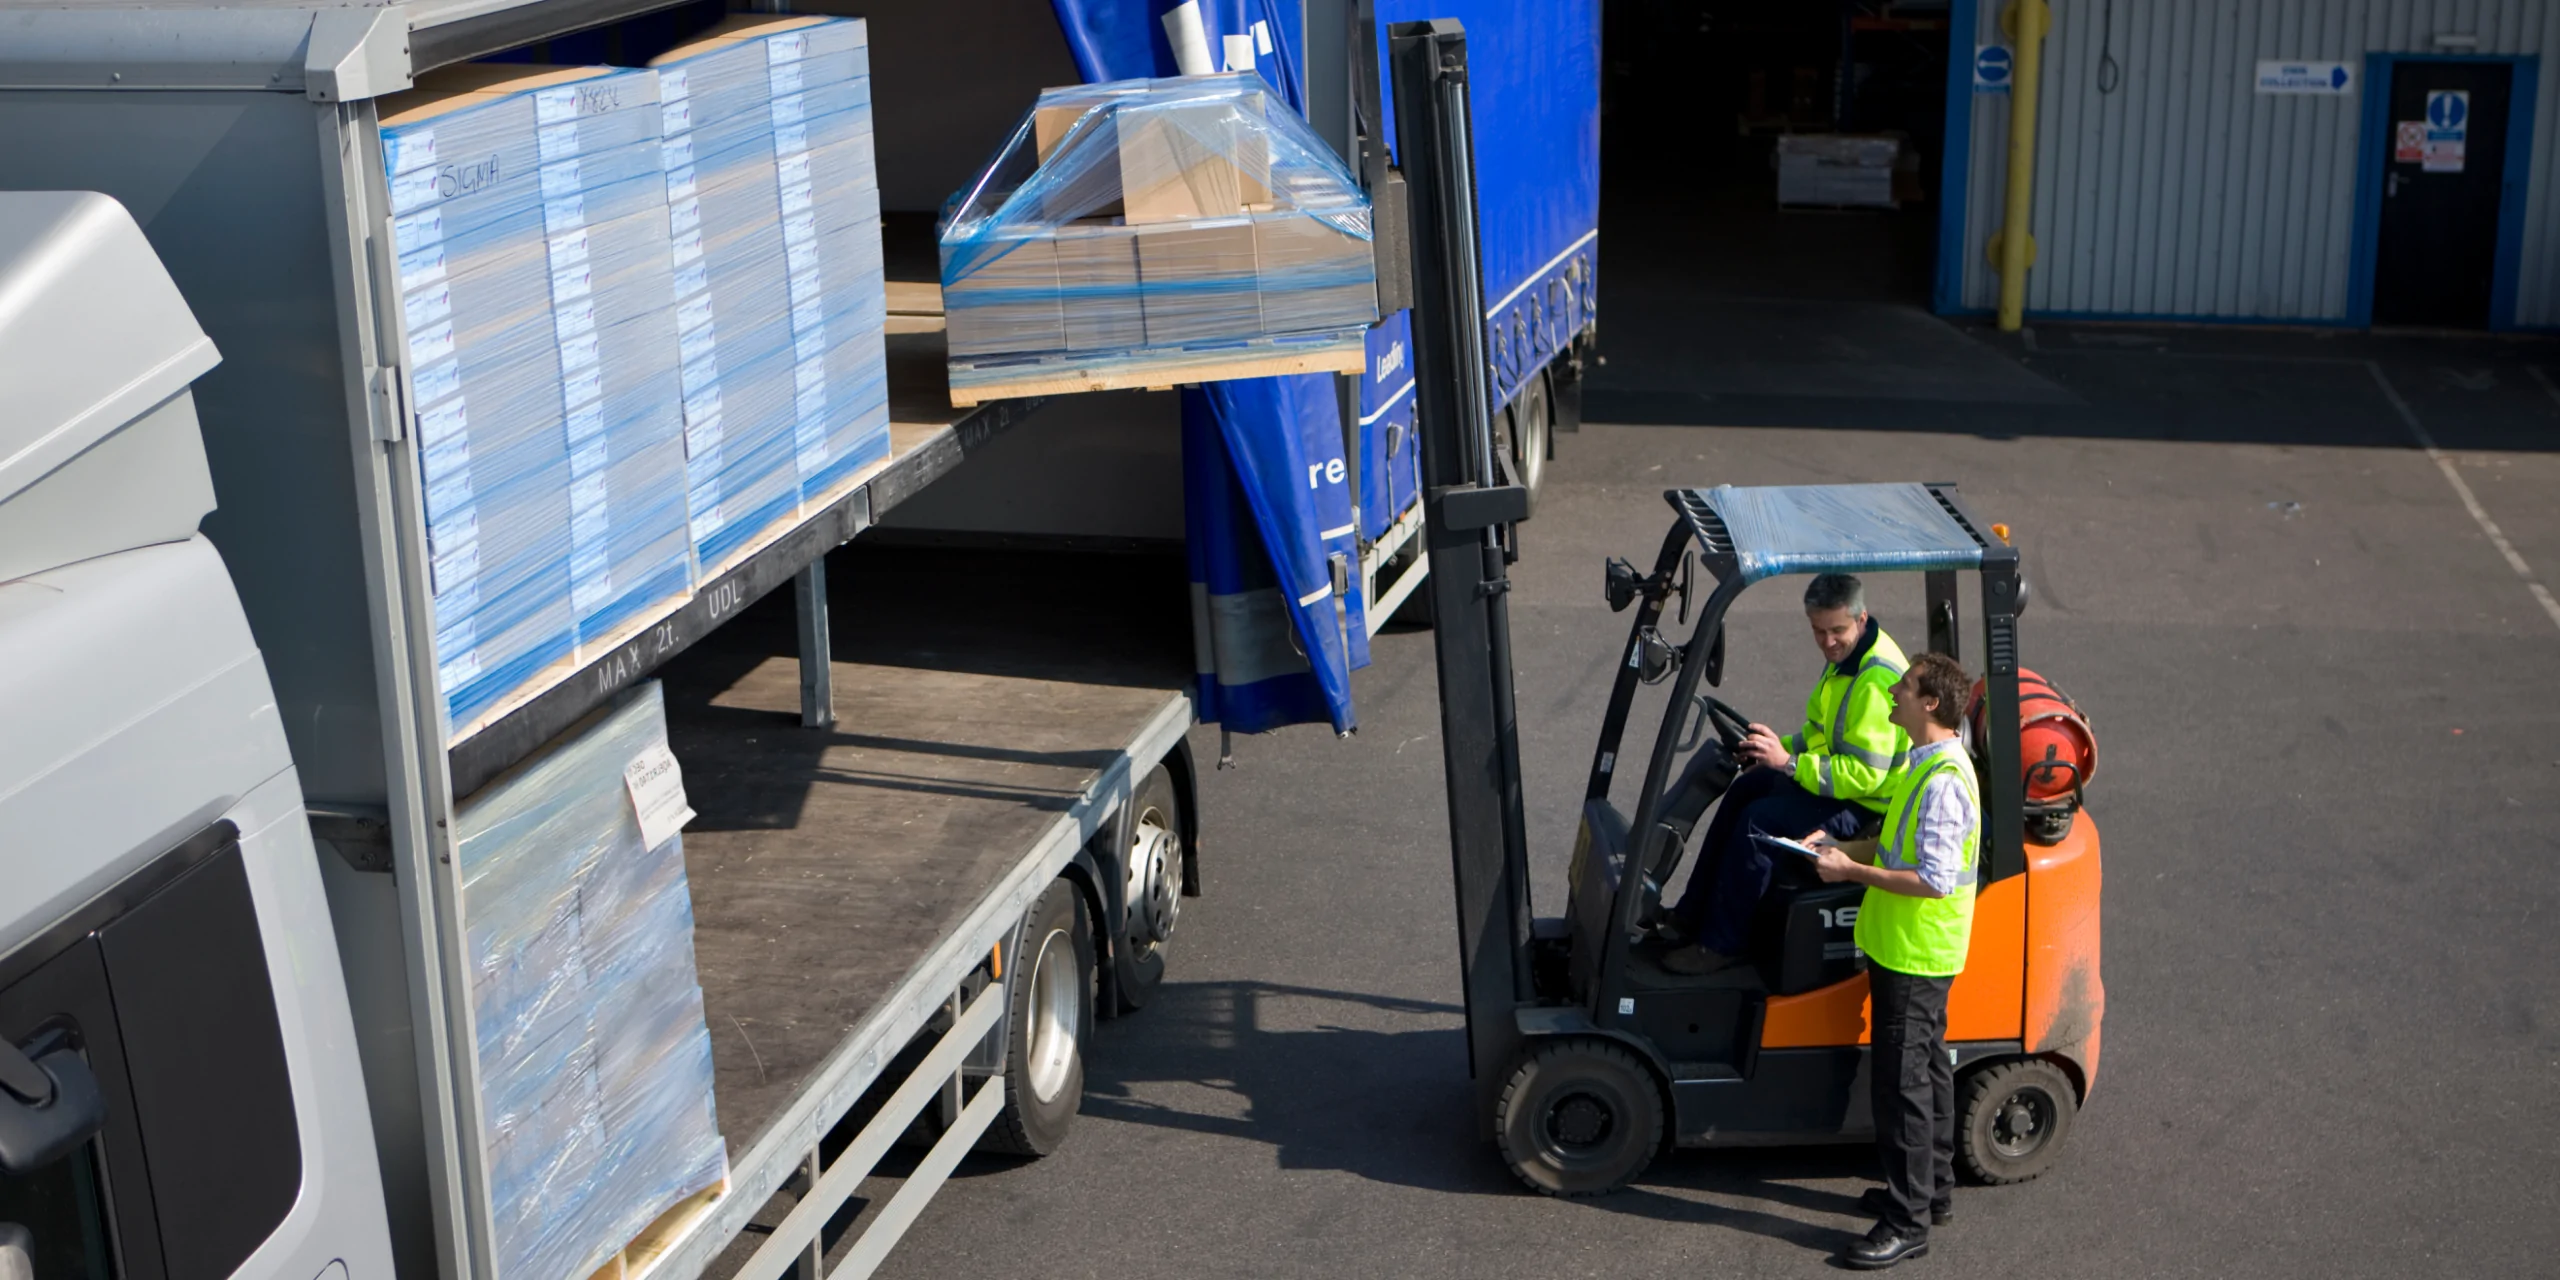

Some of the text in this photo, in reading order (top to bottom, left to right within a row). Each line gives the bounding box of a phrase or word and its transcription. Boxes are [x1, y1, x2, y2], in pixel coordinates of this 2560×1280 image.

[441, 154, 500, 198] SIGMA
[598, 642, 642, 694] MAX
[708, 578, 742, 620] UDL
